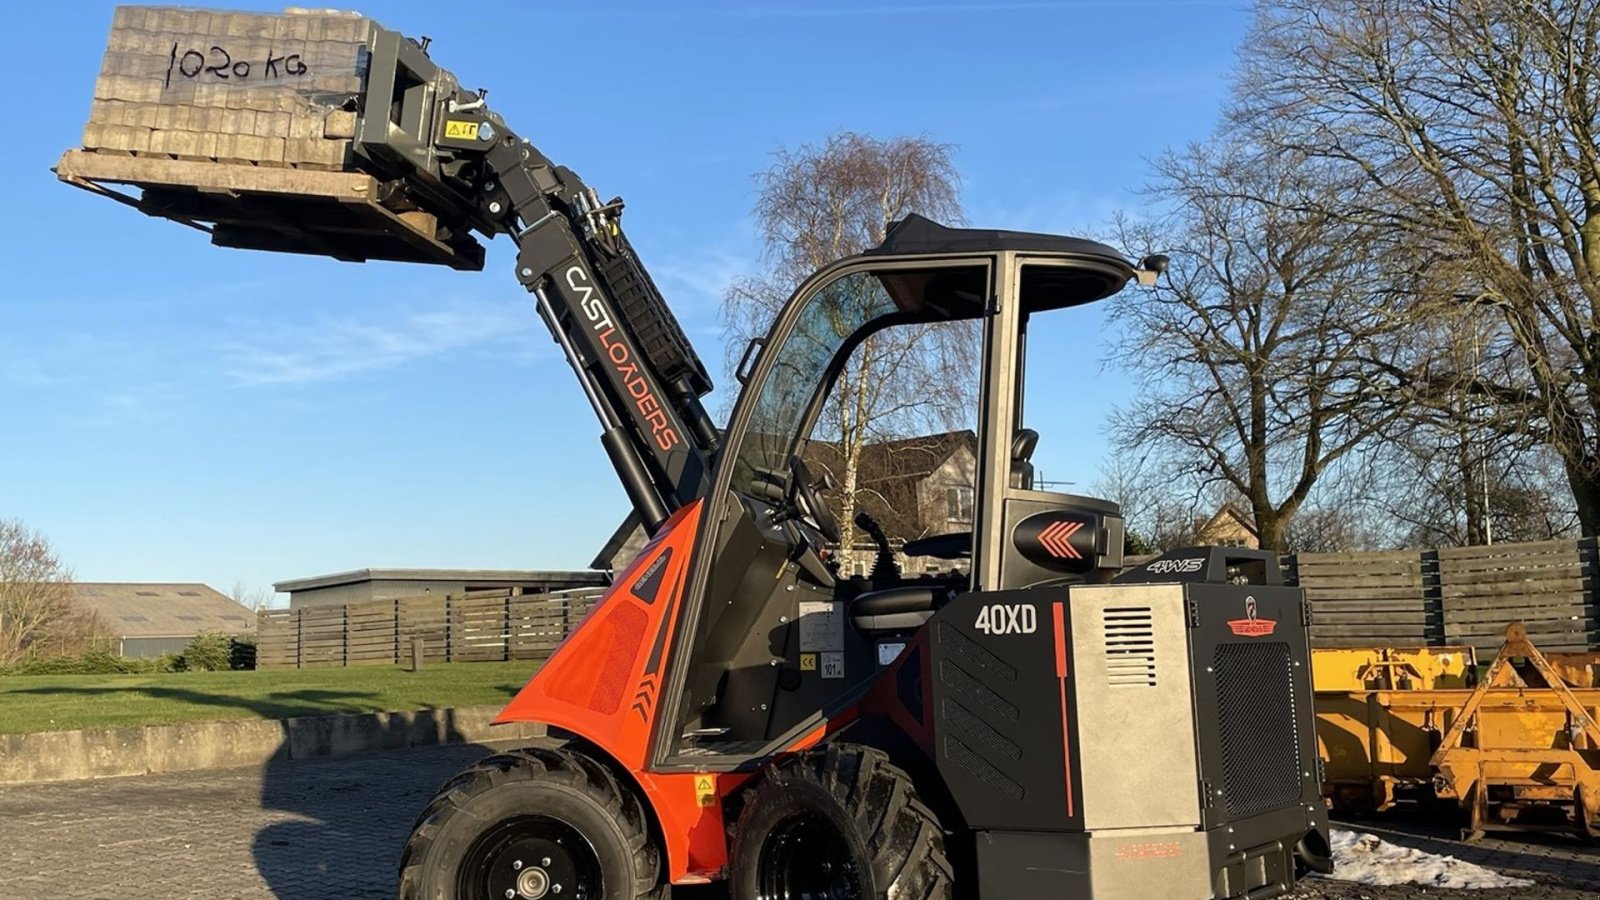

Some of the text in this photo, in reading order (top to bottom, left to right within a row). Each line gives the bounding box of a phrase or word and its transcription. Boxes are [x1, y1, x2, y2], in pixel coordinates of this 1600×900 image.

[165, 42, 250, 89] 1020
[1147, 558, 1206, 574] 4WS
[974, 604, 1037, 635] 40XD
[802, 657, 814, 667] CE
